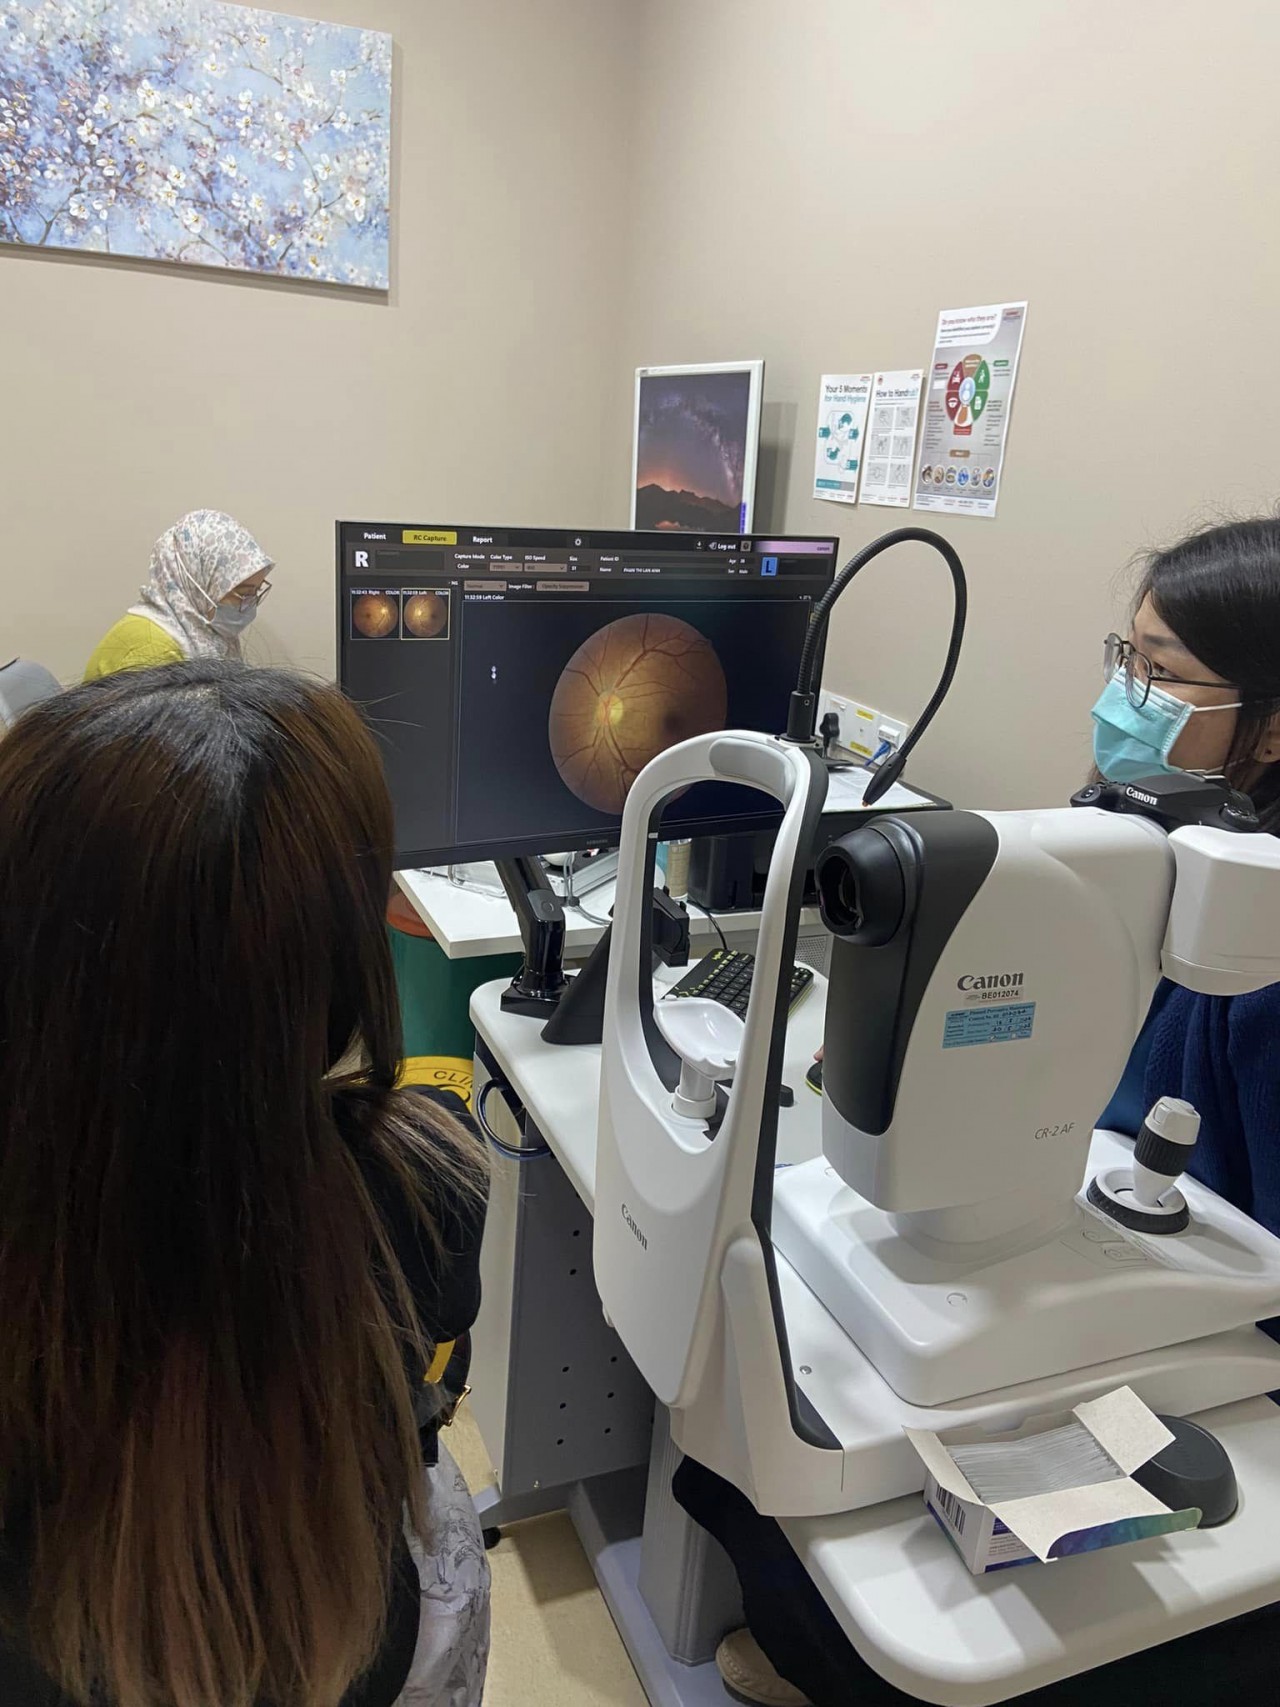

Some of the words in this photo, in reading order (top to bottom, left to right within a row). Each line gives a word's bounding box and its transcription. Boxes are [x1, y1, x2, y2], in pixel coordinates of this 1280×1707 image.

[364, 532, 386, 540] Patient
[472, 536, 493, 544] Report
[355, 551, 369, 567] R
[1126, 786, 1158, 806] Canon
[957, 972, 1024, 991] Canon
[981, 990, 1019, 1000] BE012074
[433, 1070, 473, 1088] CLI
[1034, 1125, 1060, 1140] CR-2
[1060, 1122, 1075, 1134] AF
[621, 1203, 648, 1251] Canon
